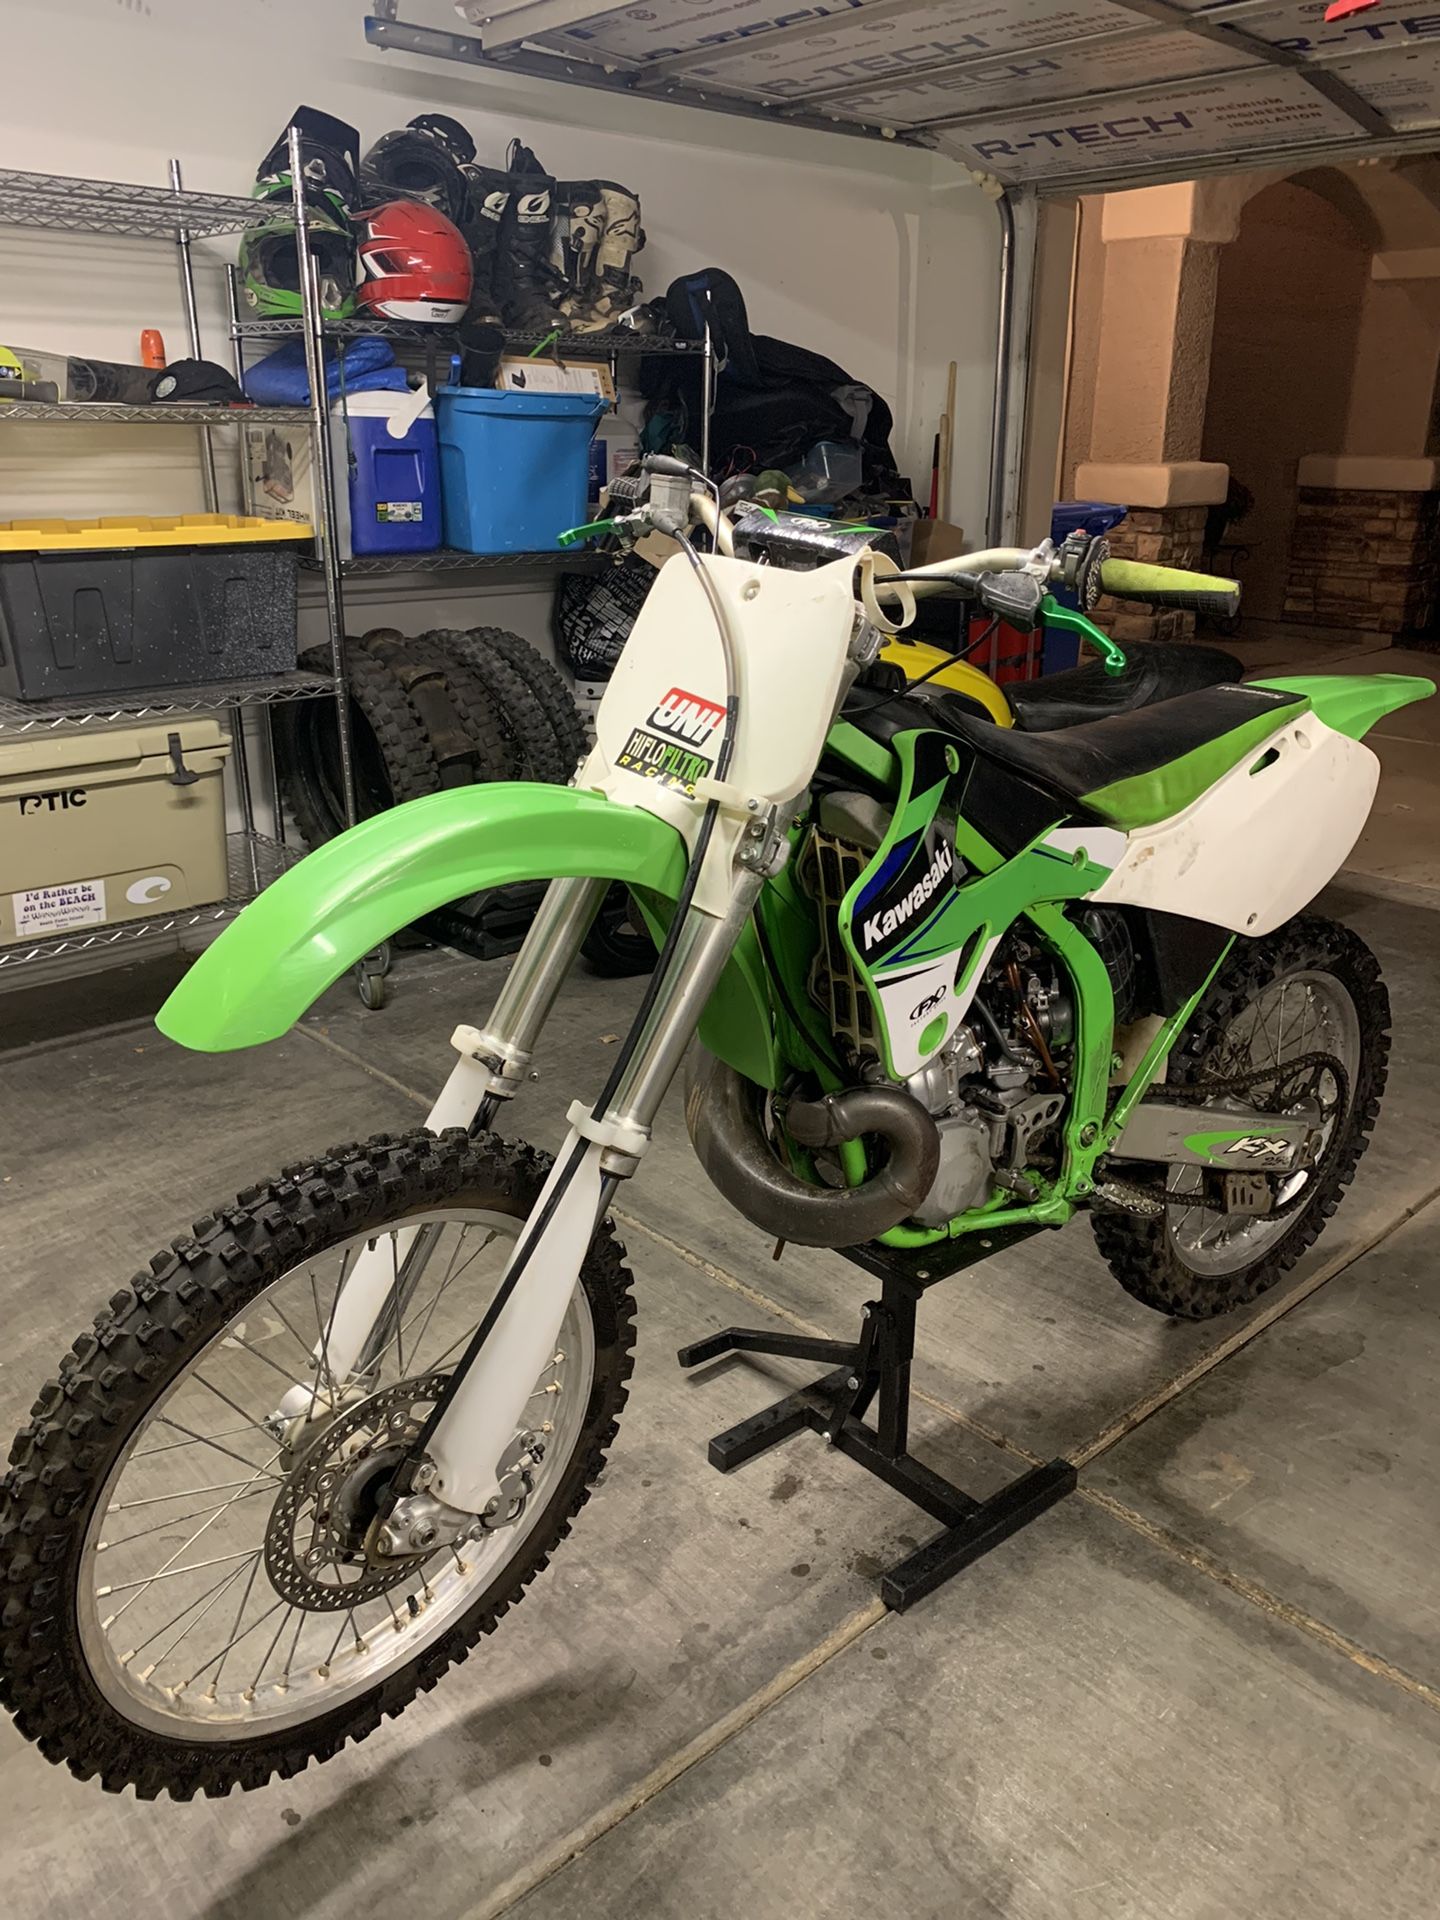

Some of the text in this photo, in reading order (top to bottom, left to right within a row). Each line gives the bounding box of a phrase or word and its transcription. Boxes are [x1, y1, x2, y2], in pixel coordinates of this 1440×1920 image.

[755, 33, 990, 96] R-TECH
[832, 58, 1063, 112] R-TECH
[972, 111, 1194, 160] R-TECH
[1205, 97, 1283, 113] PREMIUM
[1227, 111, 1323, 129] INSULATION
[652, 693, 722, 744] UNI
[619, 754, 696, 796] RACING
[625, 731, 709, 785] HIFLOFILTRO
[23, 892, 96, 913] on the BEACH
[25, 884, 93, 902] I'd Rather be
[863, 839, 952, 950] Kawasaki
[1222, 1135, 1290, 1159] KX
